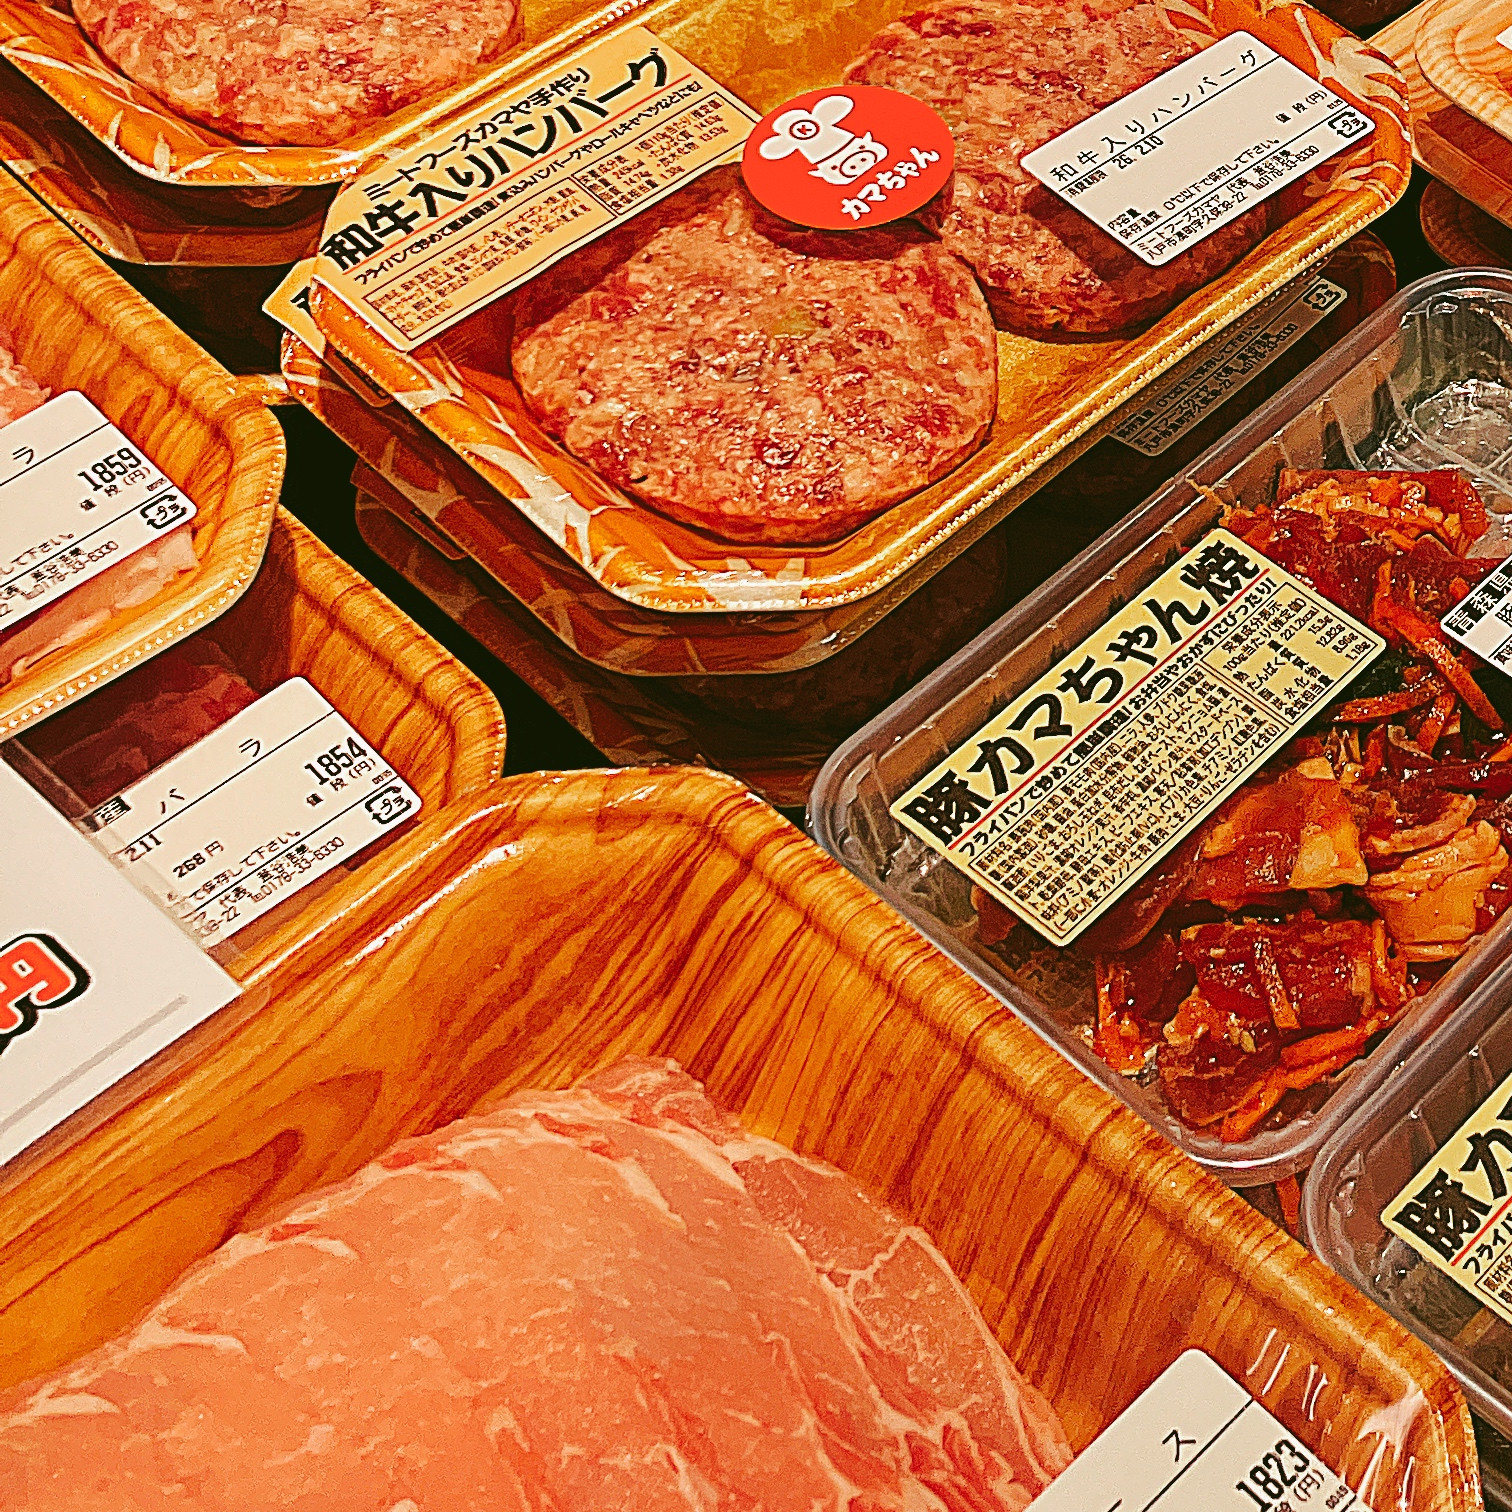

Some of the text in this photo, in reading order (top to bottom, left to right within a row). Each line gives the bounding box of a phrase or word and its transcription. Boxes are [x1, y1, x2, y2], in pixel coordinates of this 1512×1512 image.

[362, 66, 590, 197] ミートフーズカマヤ手作り
[1047, 47, 1265, 184] 和牛入りハンバーグ
[318, 46, 671, 272] 和牛入りハンバーグ
[839, 146, 941, 221] カマちゃん
[1106, 207, 1142, 231] 内容量
[79, 448, 142, 491] 1859
[899, 535, 1264, 850] 豚カマちゃん焼
[304, 737, 367, 786] 1854
[172, 838, 224, 878] 268円
[1162, 1430, 1196, 1462] ス
[1236, 1440, 1310, 1512] 1823
